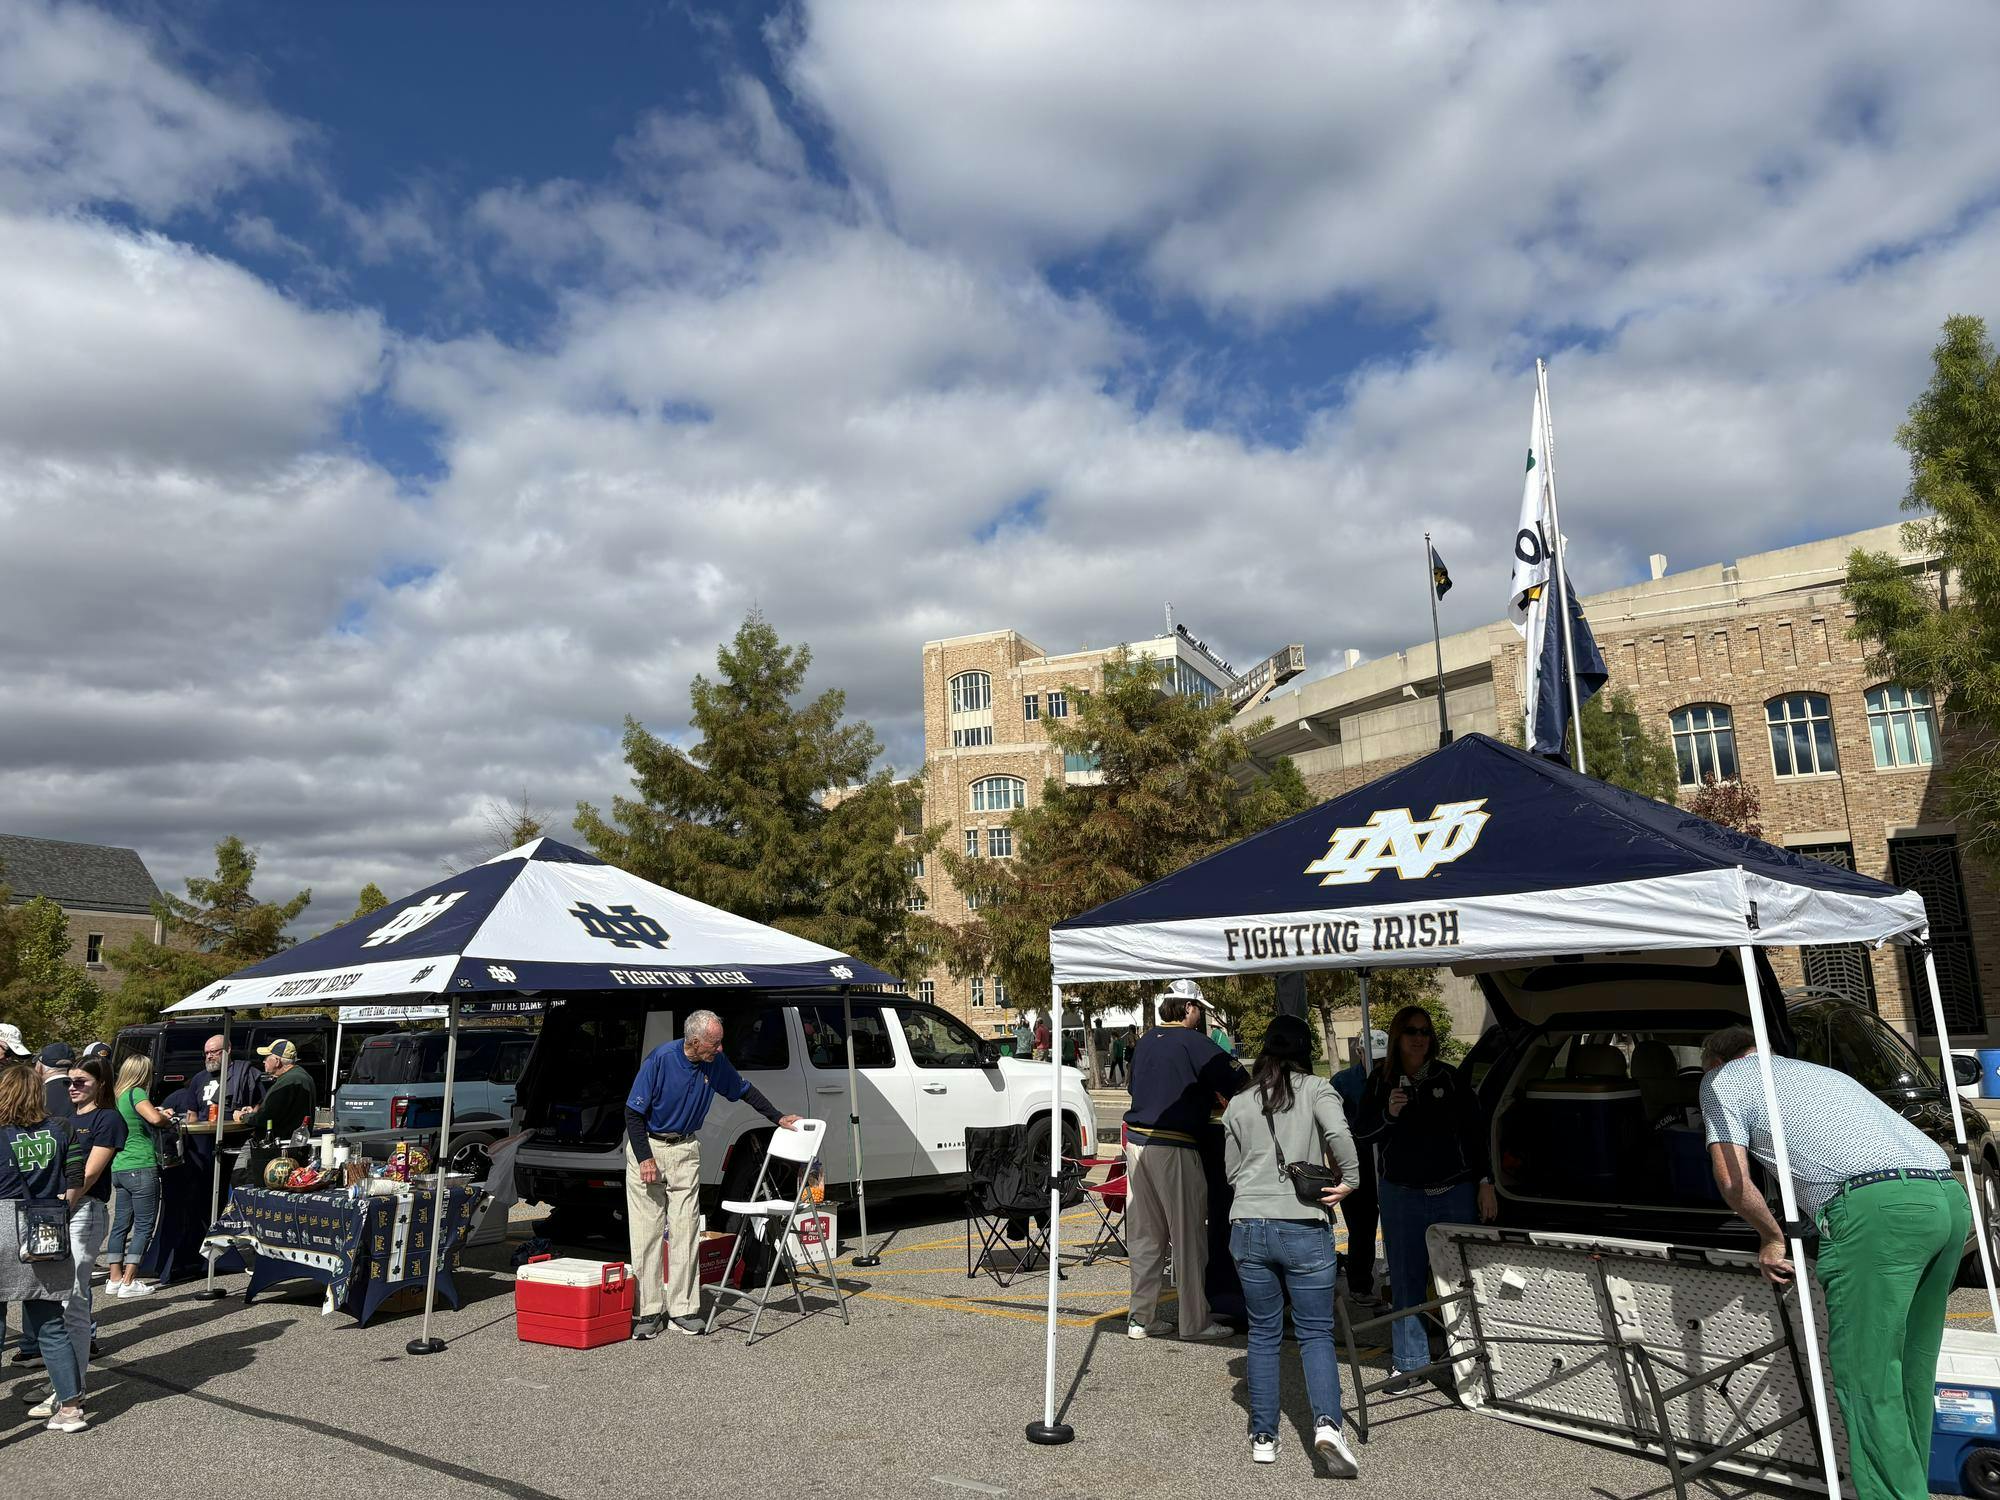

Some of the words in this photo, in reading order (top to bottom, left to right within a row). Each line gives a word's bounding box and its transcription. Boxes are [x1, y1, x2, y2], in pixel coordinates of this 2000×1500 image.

[1224, 920, 1360, 961] FIGHTING
[1372, 910, 1460, 950] IRISH
[318, 973, 364, 994] IRISH
[610, 970, 695, 985] FIGHTIN'
[695, 971, 753, 985] IRISH
[490, 1002, 518, 1011] NOTRE
[519, 1001, 543, 1011] DAME
